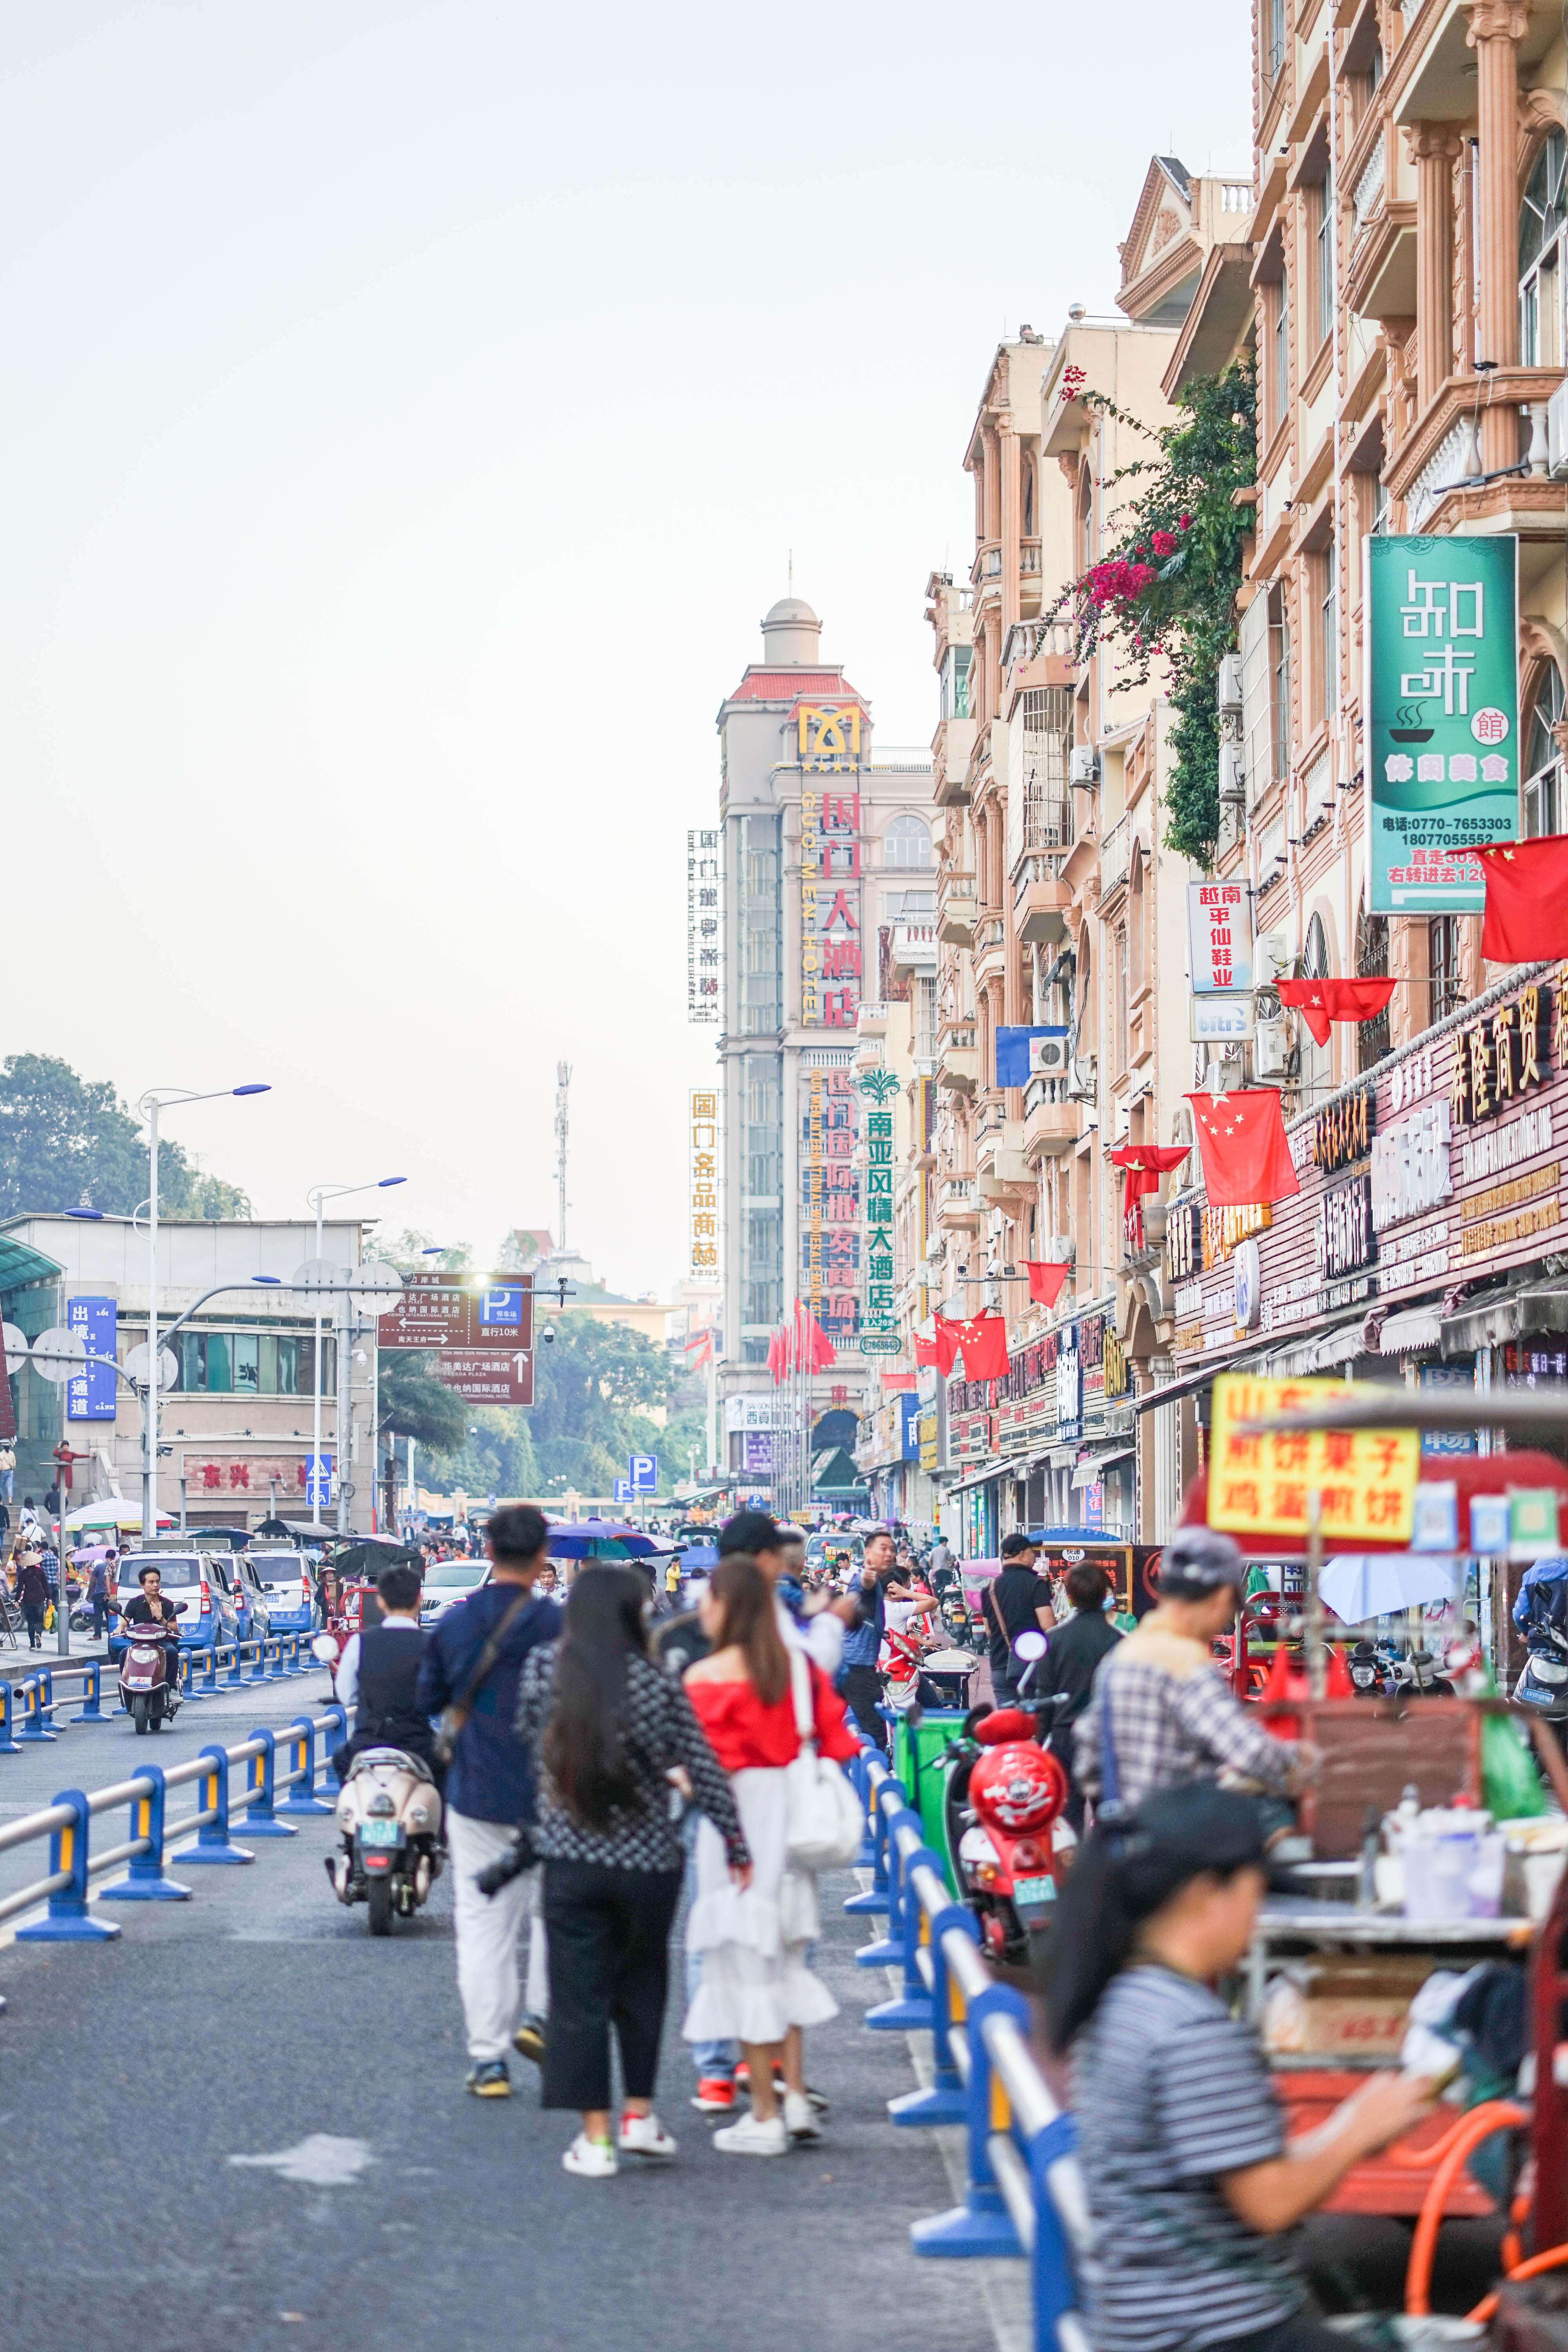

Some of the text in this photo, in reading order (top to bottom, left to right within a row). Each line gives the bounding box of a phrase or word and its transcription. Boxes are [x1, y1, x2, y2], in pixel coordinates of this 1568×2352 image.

[1400, 569, 1484, 715] 知味
[1476, 712, 1504, 740] 館
[1385, 754, 1508, 783] 休闲美食
[1402, 833, 1494, 846] 18077055552
[802, 791, 817, 1026] GUO MEN HOTEL
[822, 793, 861, 1027] 国门大酒店
[1199, 886, 1241, 905] 越南
[1209, 907, 1233, 987] 平仙鞋业
[810, 1070, 822, 1093] GUO
[810, 1096, 822, 1118] MEN
[810, 1119, 822, 1207] INTERNATIONAL
[692, 1094, 717, 1266] 国门名品商场
[867, 1112, 892, 1308] 南亚风情大酒店
[481, 1328, 518, 1336] 直行10米
[633, 1458, 653, 1481] P
